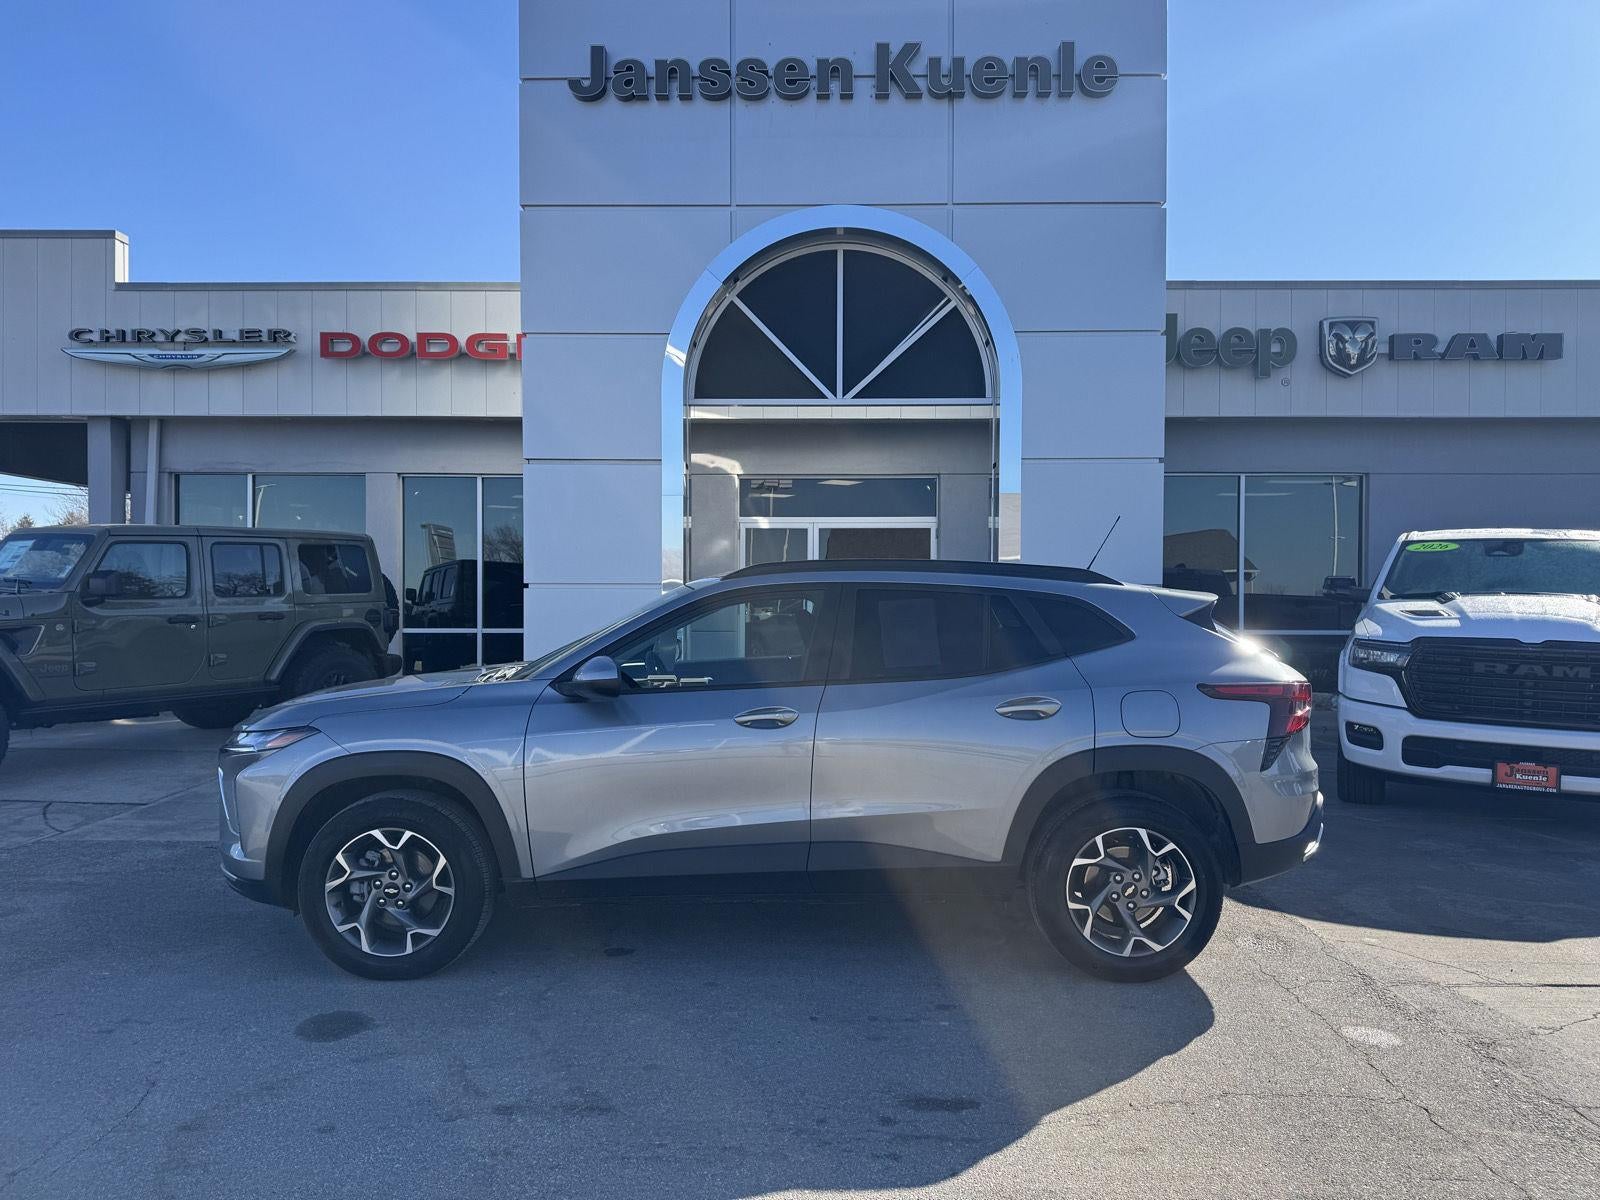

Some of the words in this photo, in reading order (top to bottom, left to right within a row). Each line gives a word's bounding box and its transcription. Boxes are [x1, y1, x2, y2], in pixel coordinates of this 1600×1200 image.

[568, 45, 854, 101] Janssen
[875, 41, 1119, 100] Kuenle
[68, 327, 296, 344] CHRYSLER
[319, 331, 522, 361] DODG
[1389, 332, 1564, 361] RAM
[1473, 662, 1591, 679] RAM
[1515, 773, 1548, 782] Kuenle
